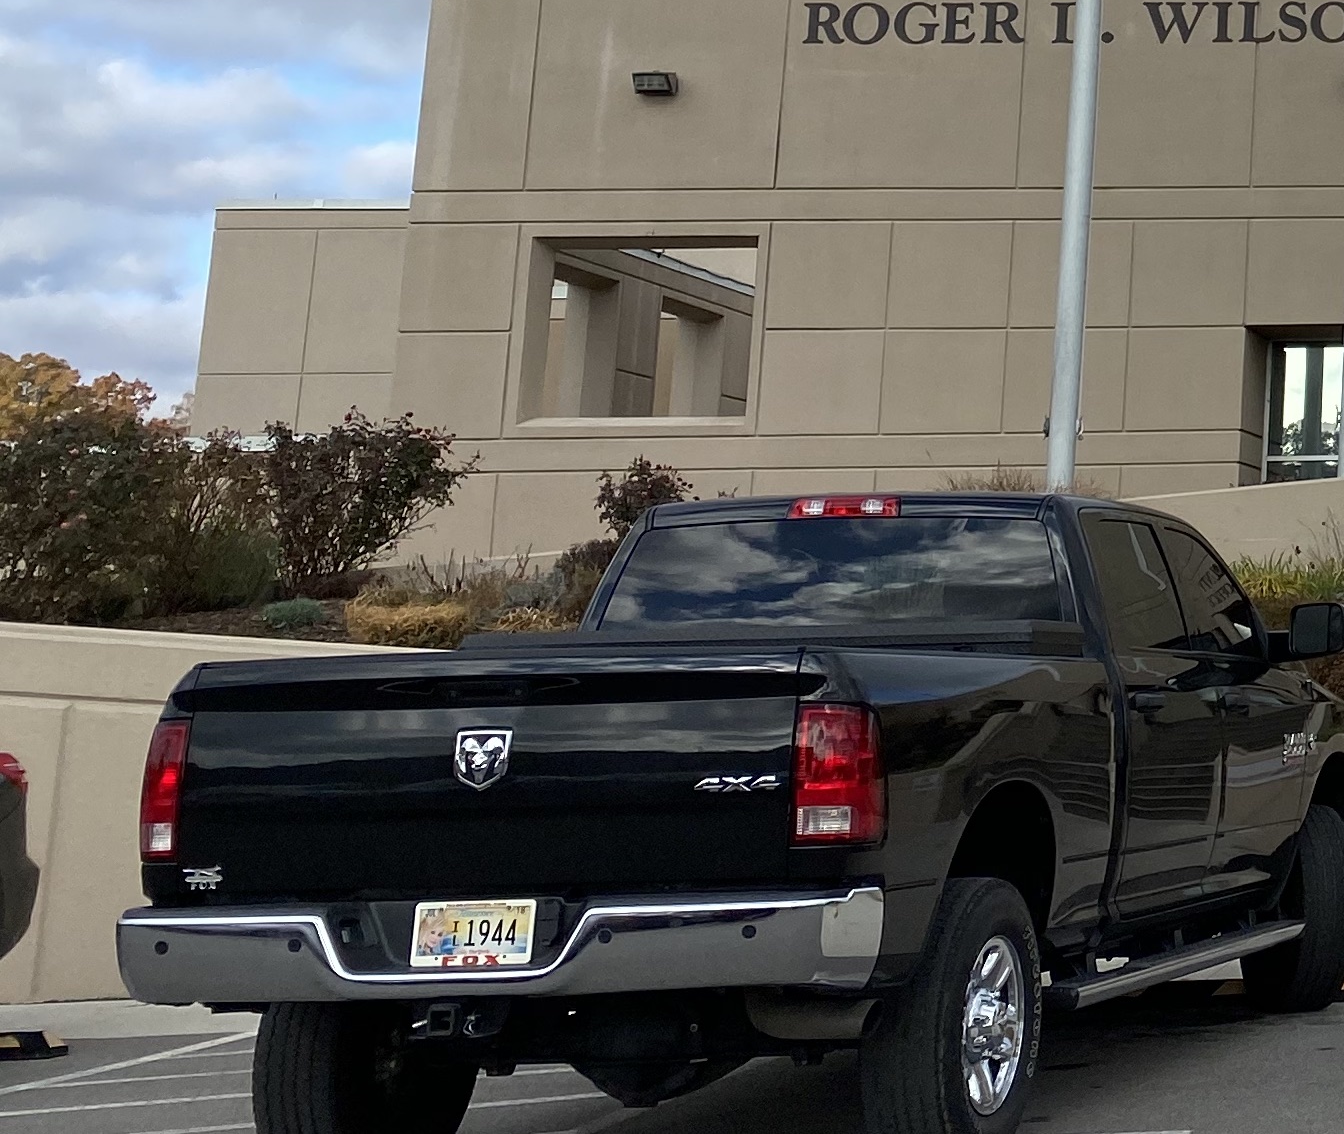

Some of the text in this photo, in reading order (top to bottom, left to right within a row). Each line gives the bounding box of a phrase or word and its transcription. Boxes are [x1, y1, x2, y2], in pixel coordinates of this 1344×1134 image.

[803, 1, 1026, 45] ROGER
[463, 918, 518, 947] 1944
[441, 954, 501, 968] FOX
